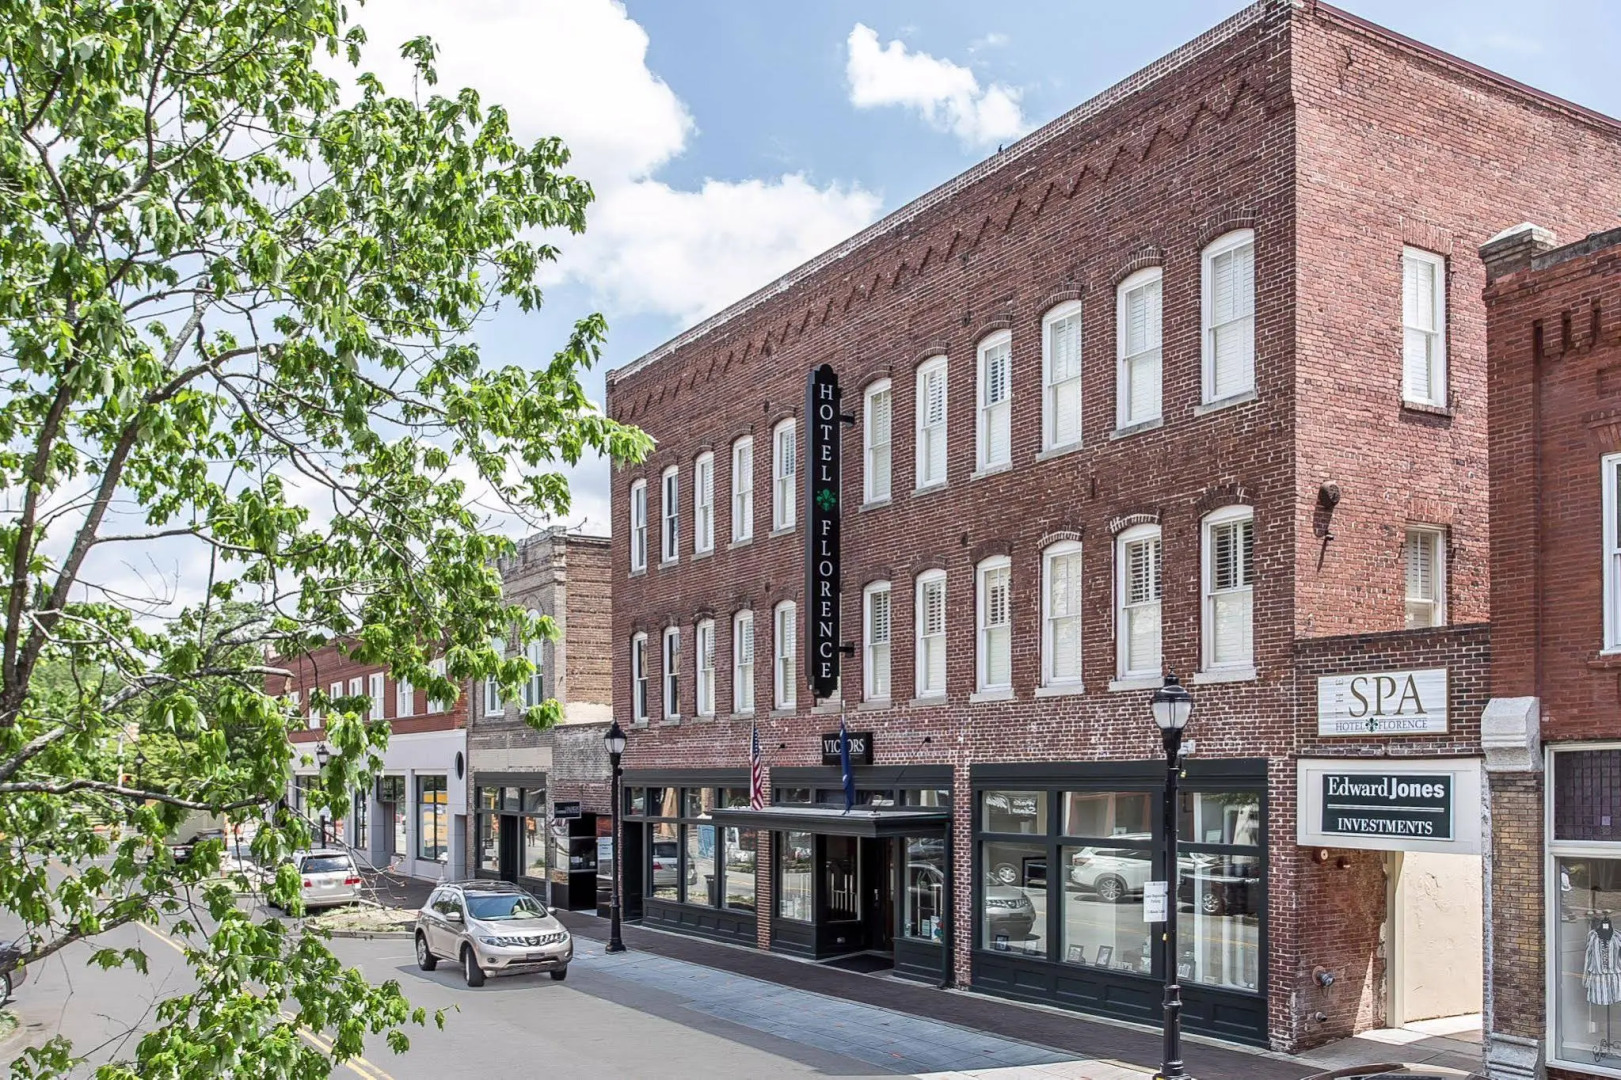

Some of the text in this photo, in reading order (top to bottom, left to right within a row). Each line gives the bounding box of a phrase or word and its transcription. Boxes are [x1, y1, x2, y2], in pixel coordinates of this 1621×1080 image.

[818, 384, 833, 678] HOTEL FLORENCE
[1348, 673, 1428, 718] SPA
[1335, 719, 1428, 731] HOTEL FLORENCE
[824, 738, 865, 753] VICORS
[1327, 776, 1445, 800] Edward Jones
[1337, 817, 1433, 835] INVESTMENTS
